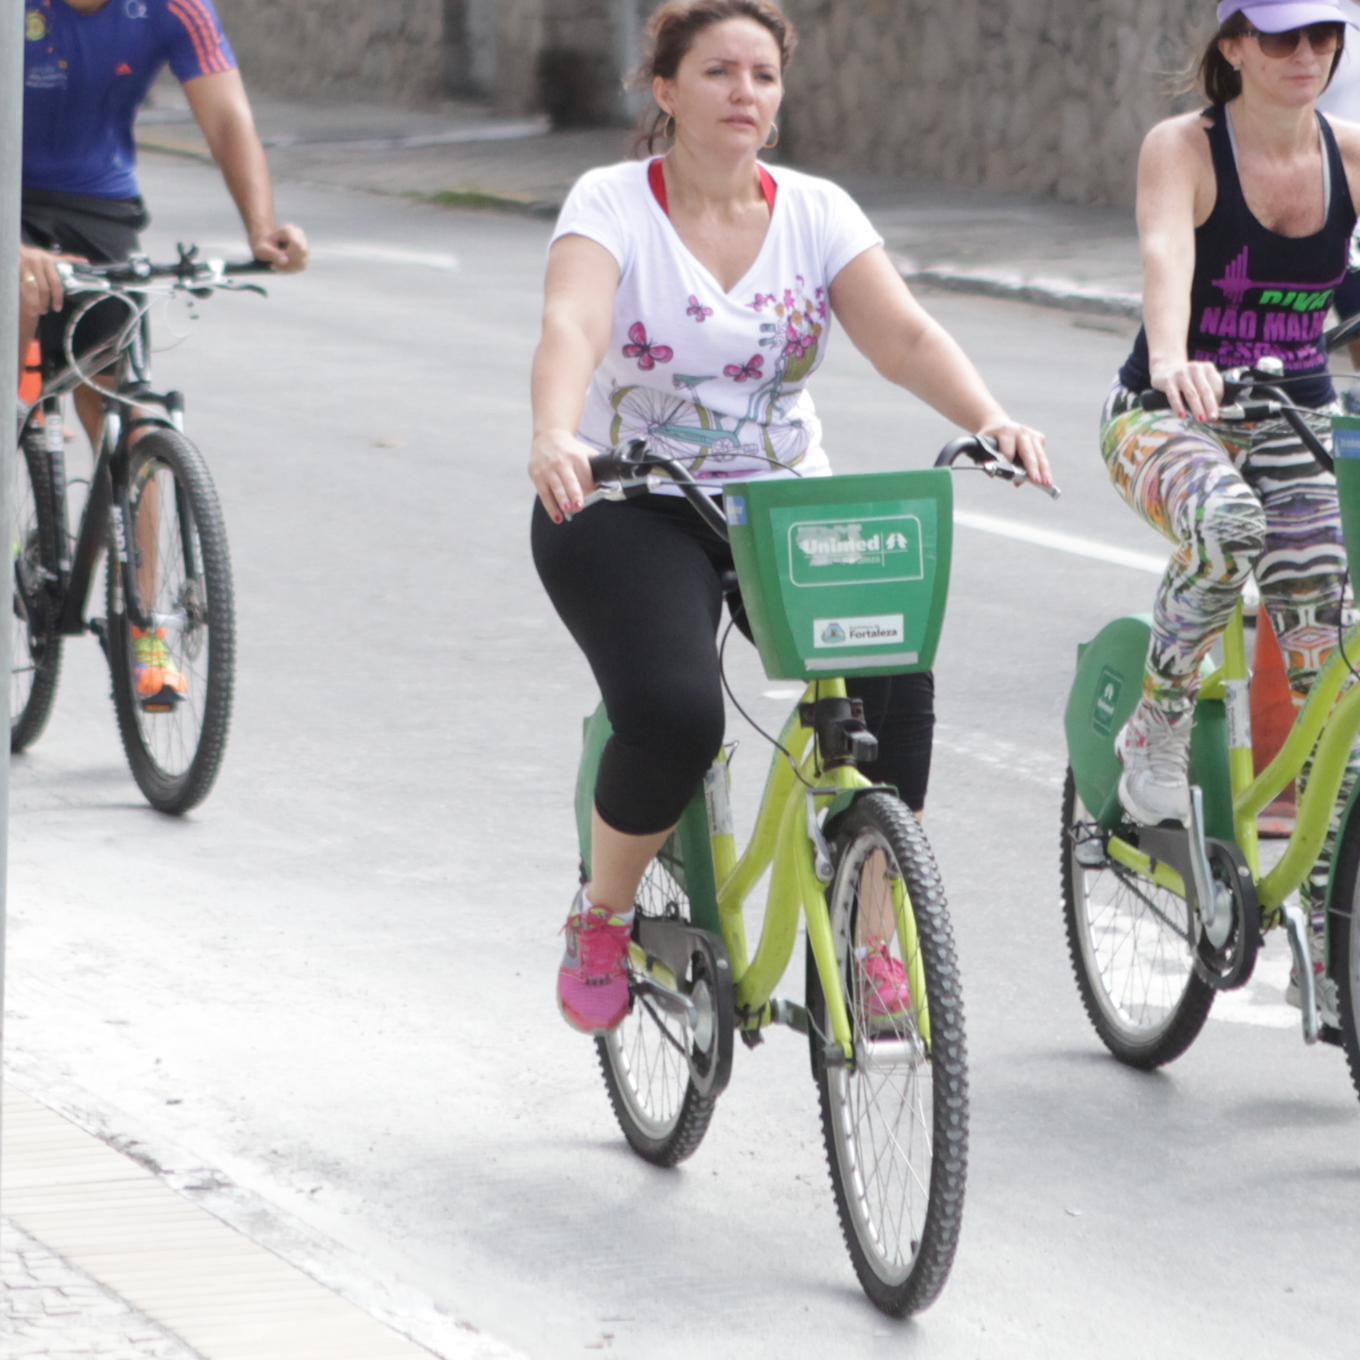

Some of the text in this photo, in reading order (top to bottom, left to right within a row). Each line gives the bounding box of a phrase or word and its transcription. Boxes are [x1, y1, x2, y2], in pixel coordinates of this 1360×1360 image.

[1199, 304, 1258, 340] NÃO
[802, 534, 880, 555] Unimed
[849, 628, 898, 639] Fortaleza
